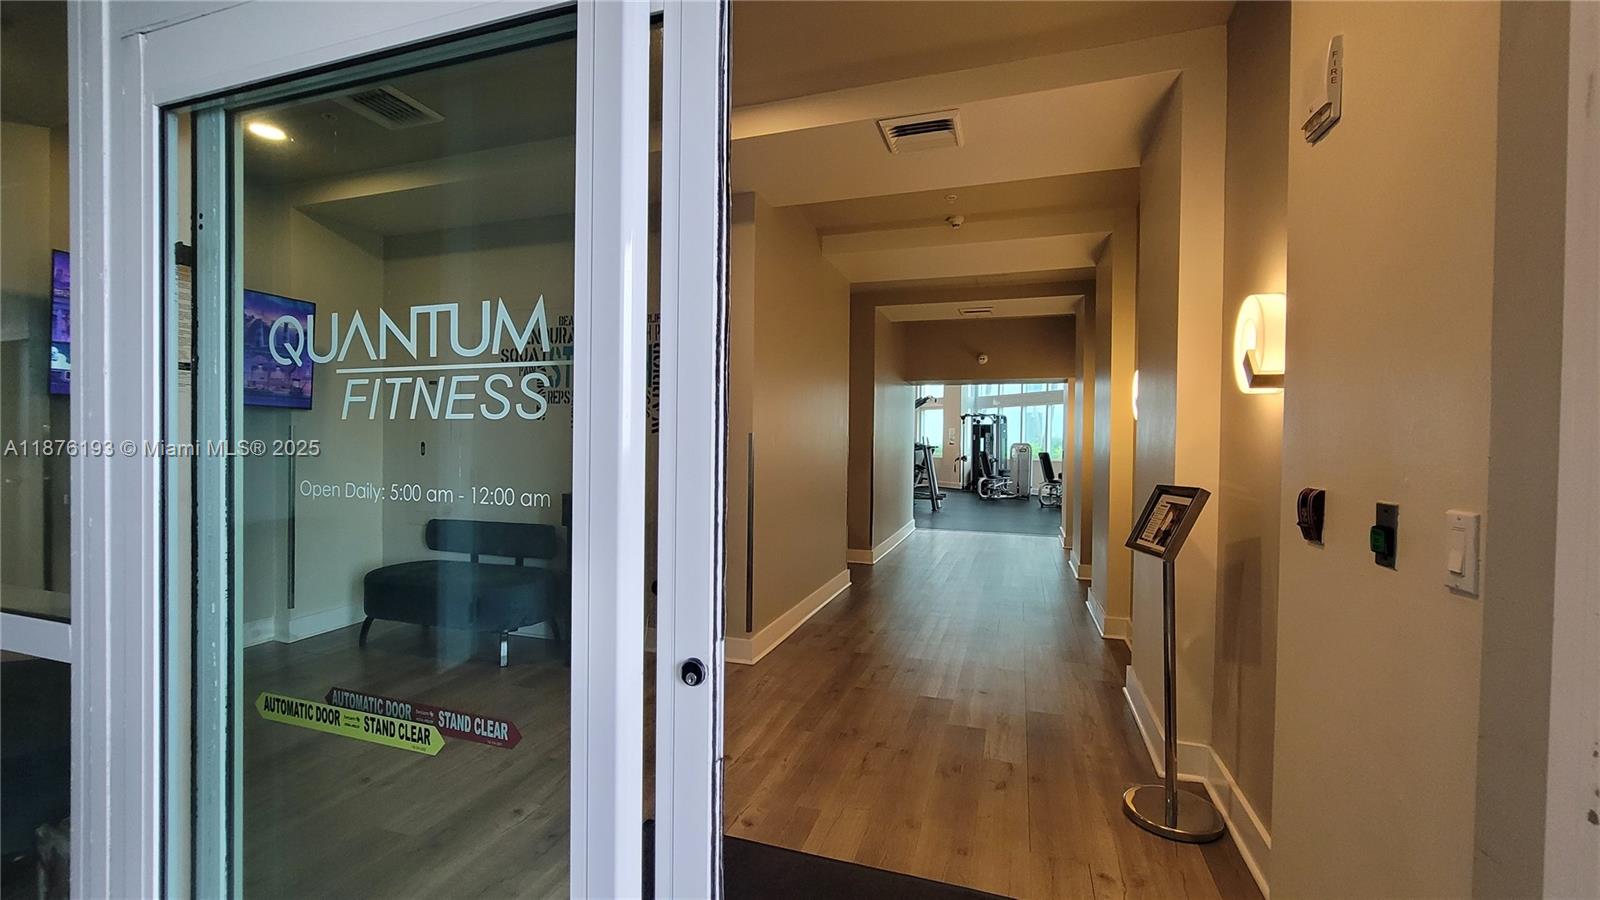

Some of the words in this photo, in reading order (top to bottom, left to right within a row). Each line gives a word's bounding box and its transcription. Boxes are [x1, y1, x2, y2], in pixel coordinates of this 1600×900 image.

[1330, 50, 1338, 85] FIRE
[268, 293, 551, 367] QUANTUM
[341, 372, 549, 421] FITNESS
[547, 390, 570, 404] REPS
[300, 480, 341, 501] Open
[345, 482, 385, 503] Daily:
[390, 483, 422, 501] 5:00
[426, 488, 453, 503] am
[471, 486, 515, 506] 12:00
[520, 492, 551, 508] am
[263, 695, 314, 721] AUTOMATIC
[315, 705, 341, 726] DOOR
[364, 715, 396, 738] STAND
[398, 722, 431, 746] CLEAR
[332, 690, 383, 714] AUTOMATIC
[385, 700, 412, 720] DOOR
[438, 710, 472, 733] STAND
[474, 717, 508, 741] CLEAR
